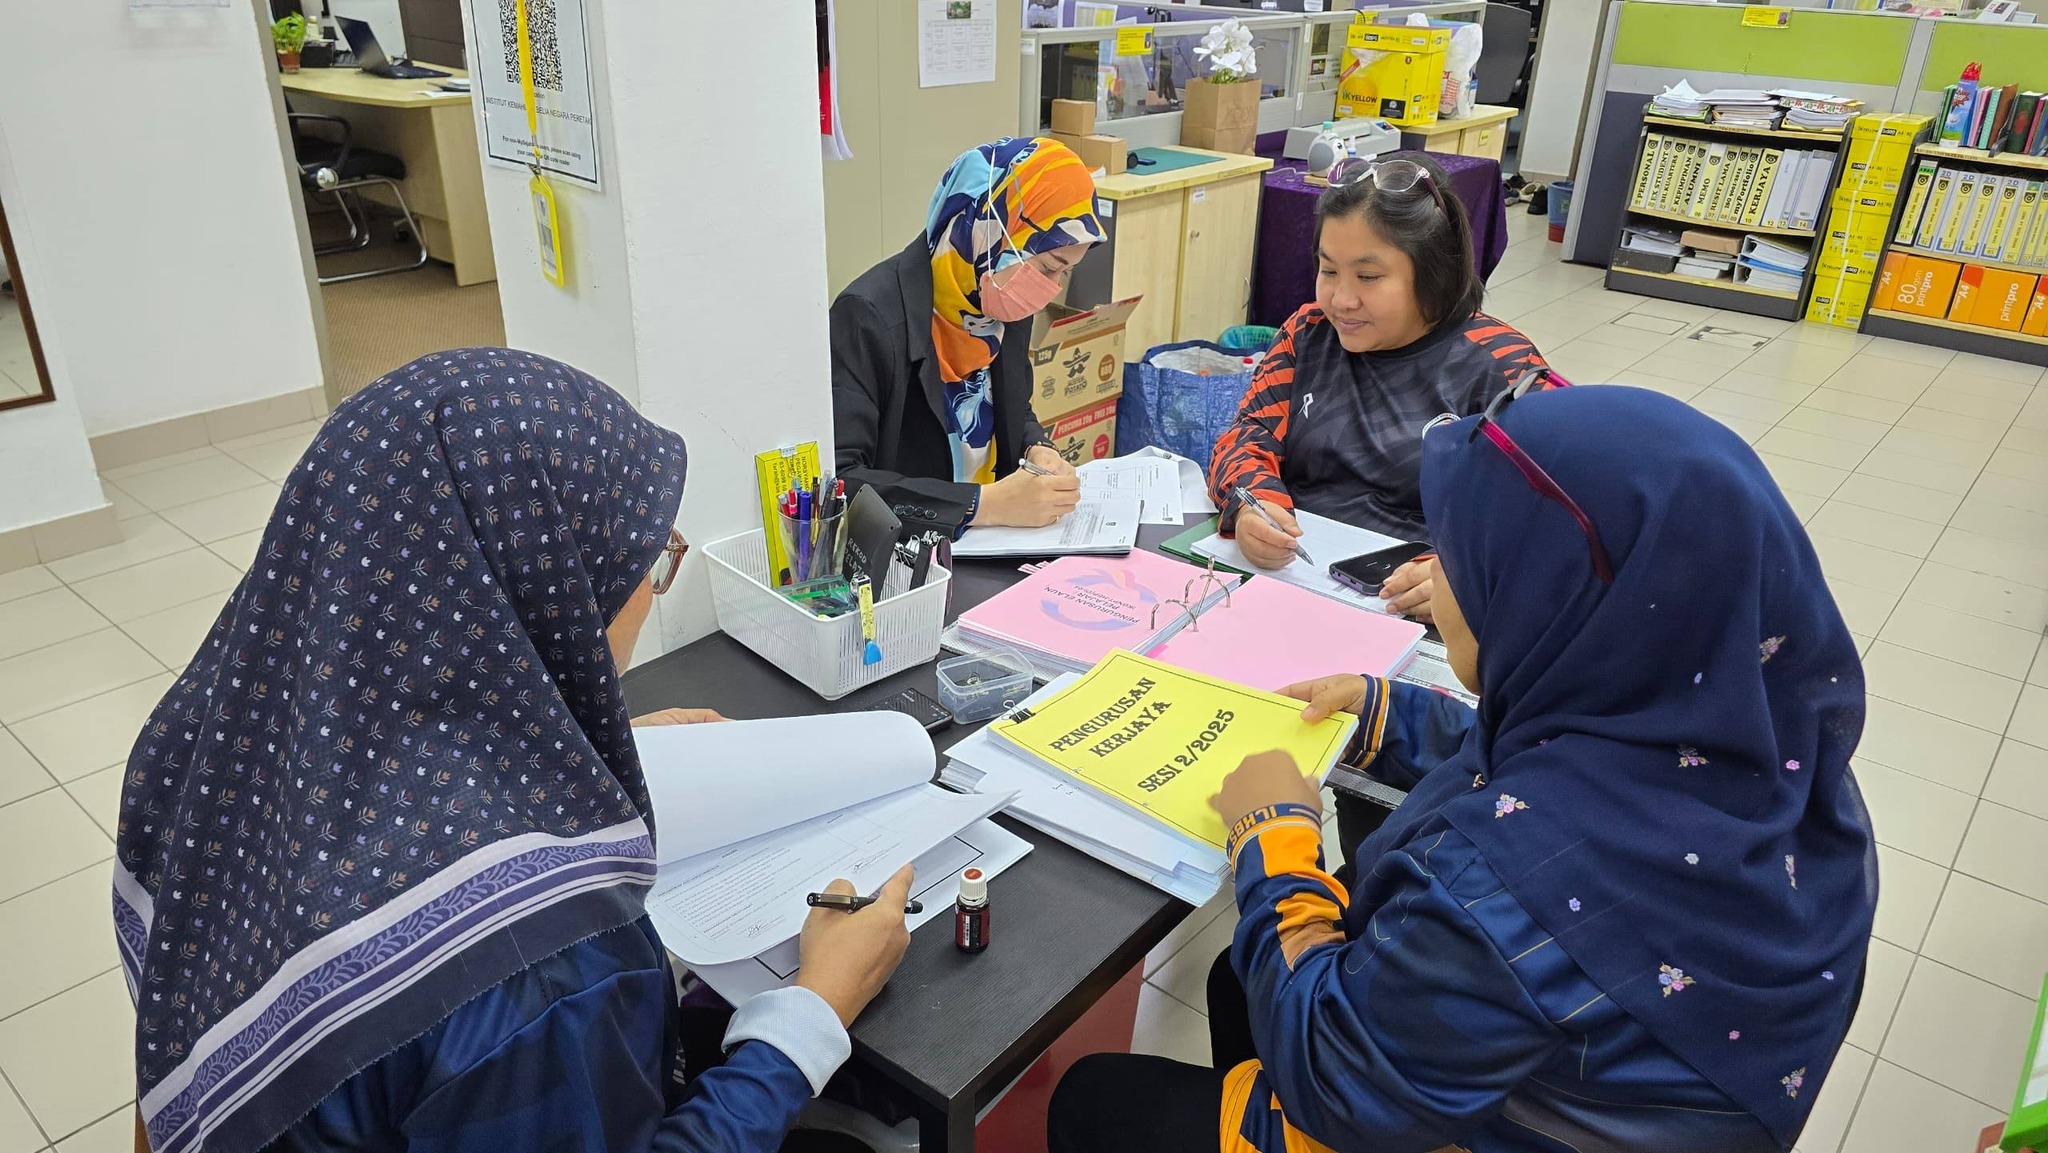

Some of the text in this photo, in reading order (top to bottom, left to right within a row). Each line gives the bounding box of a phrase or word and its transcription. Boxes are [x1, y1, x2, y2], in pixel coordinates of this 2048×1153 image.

[550, 108, 569, 119] NEGARA
[1351, 94, 1377, 103] YELLOW
[1637, 150, 1655, 199] PERSONAL
[1651, 150, 1669, 201] EX STUDENT
[1664, 155, 1679, 192] KUARTERS
[1673, 156, 1692, 205] KEPIMPINAN
[1684, 162, 1702, 205] ALUMNI
[1697, 178, 1711, 205] MEMO
[1711, 162, 1730, 211] RESIT LAMA
[1733, 163, 1755, 215] myPortfolio
[1749, 166, 1771, 215] KERJAYA
[1883, 271, 1892, 285] A4
[1898, 284, 1917, 304] 80
[1917, 271, 1933, 307] printpro
[1959, 285, 1970, 299] A4
[2000, 283, 2019, 322] printpro
[2034, 295, 2046, 310] A4
[1064, 381, 1087, 397] POTATO
[1058, 418, 1082, 435] PERCUMA
[1094, 408, 1105, 420] FREE
[848, 537, 867, 564] REKOD
[1044, 585, 1140, 623] PENGURUSAN ELAUN
[1077, 592, 1119, 610] PELAJAR
[1048, 676, 1157, 753] PENGURUSAN
[1088, 700, 1173, 758] KERJAYA
[1137, 708, 1235, 793] SESI 2/2025
[1229, 805, 1277, 845] ILKBS
